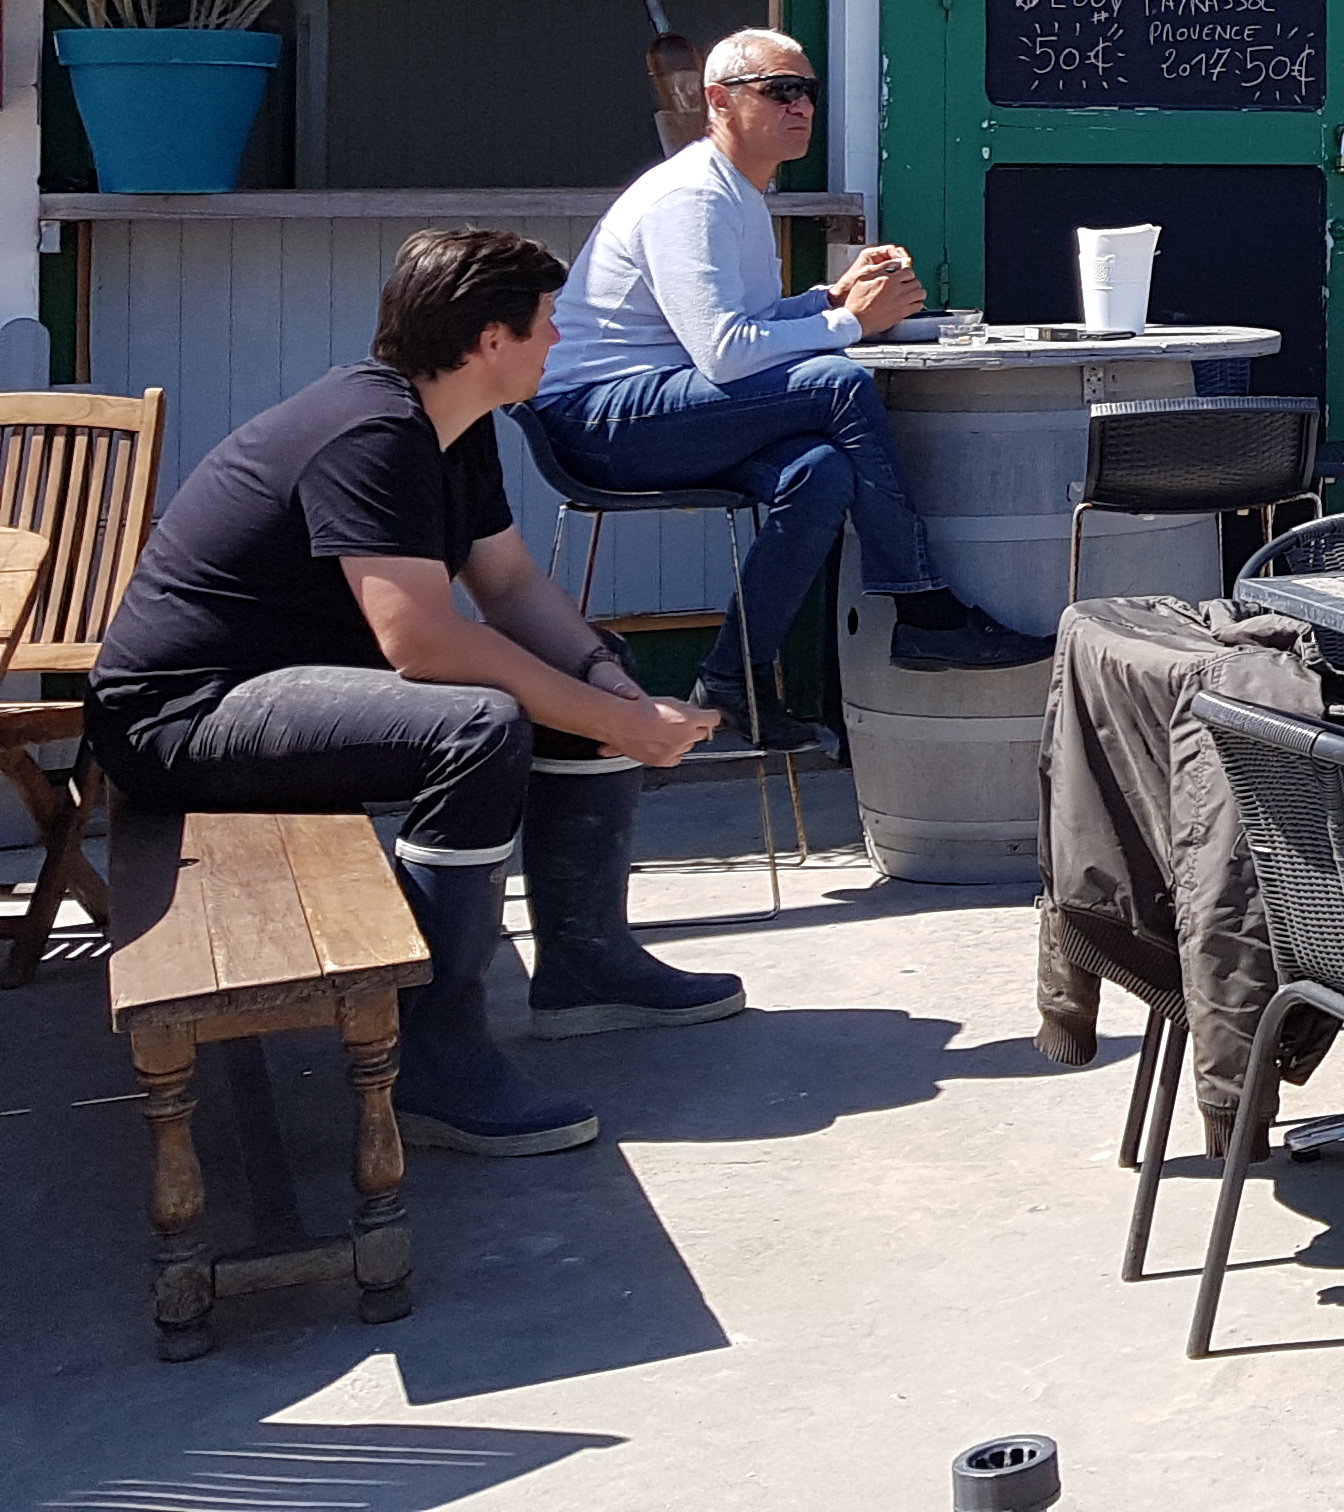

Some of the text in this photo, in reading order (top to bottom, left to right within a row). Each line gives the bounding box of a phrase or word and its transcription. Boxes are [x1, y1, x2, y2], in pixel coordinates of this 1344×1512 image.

[1033, 36, 1316, 95] 50€ 2017 50€
